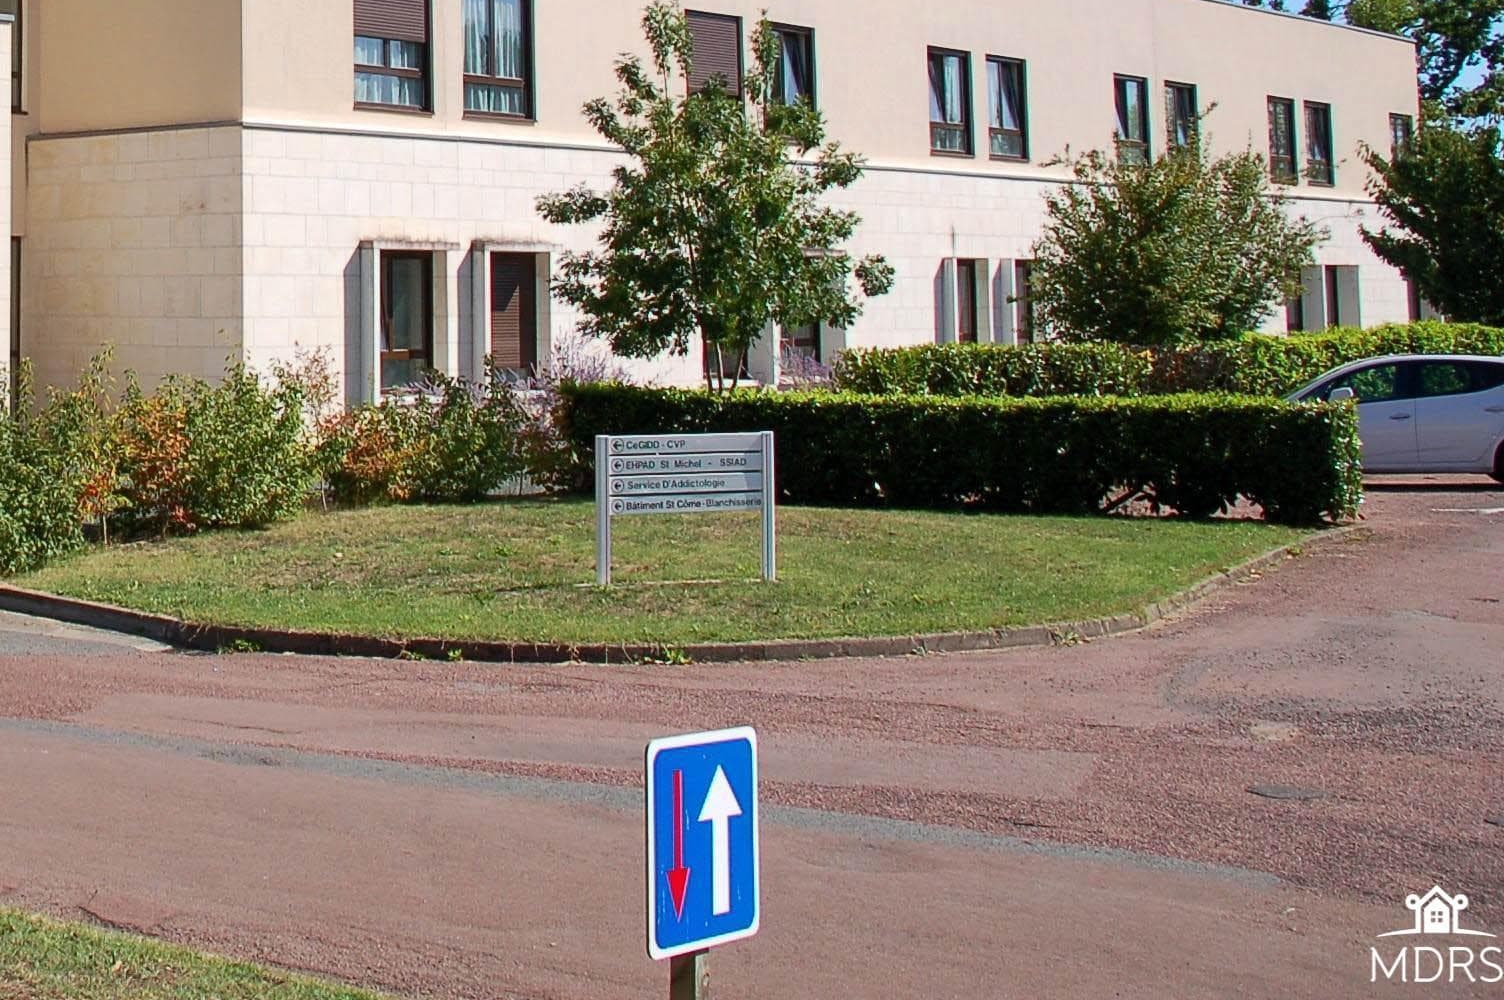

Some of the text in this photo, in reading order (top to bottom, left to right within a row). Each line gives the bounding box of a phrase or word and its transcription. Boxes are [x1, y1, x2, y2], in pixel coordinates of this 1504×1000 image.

[667, 439, 686, 449] CVP
[626, 460, 656, 470] EHPAD
[660, 459, 670, 469] St
[674, 458, 702, 469] Michel
[719, 457, 747, 467] SSIAD
[627, 480, 661, 490] Service
[665, 500, 675, 510] St
